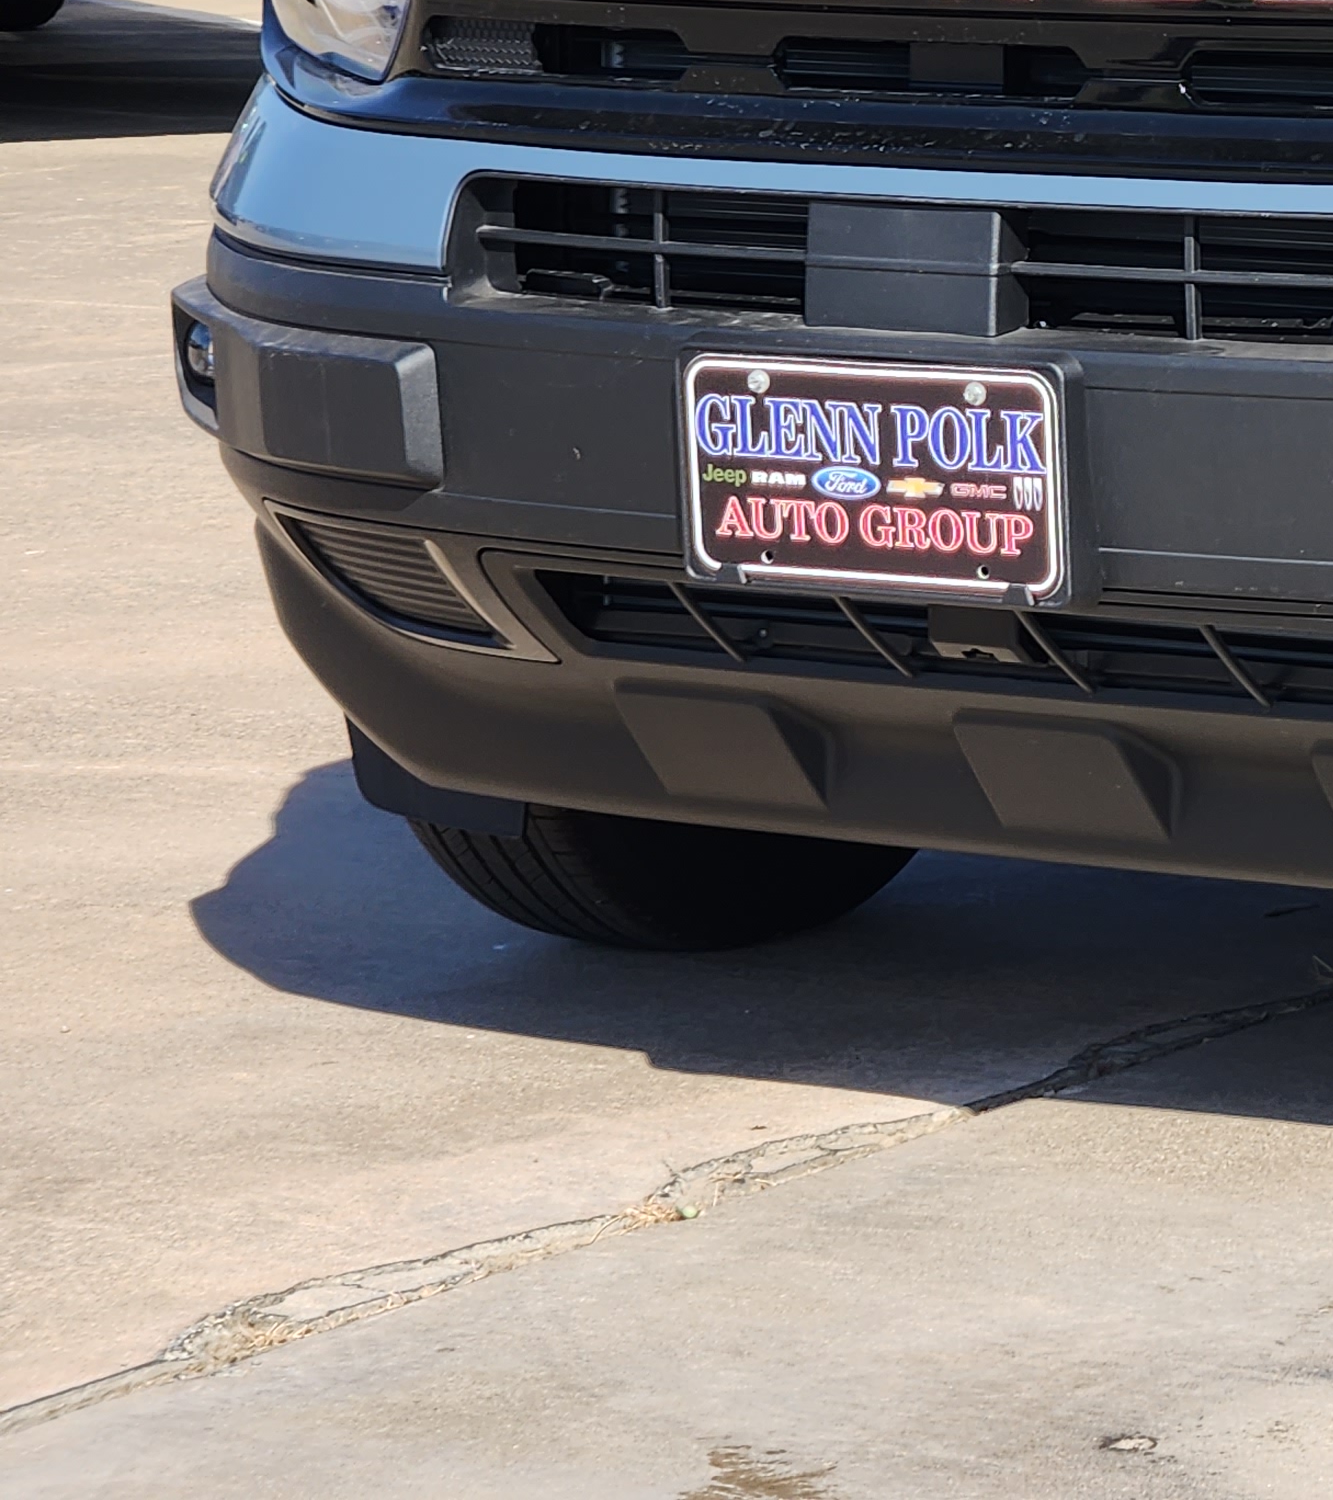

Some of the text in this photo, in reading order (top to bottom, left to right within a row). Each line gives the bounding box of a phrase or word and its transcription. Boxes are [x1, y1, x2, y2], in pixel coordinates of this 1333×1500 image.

[695, 393, 1046, 474] GLENN POLK
[702, 464, 1007, 499] Jeep RAM Ford GMC
[716, 496, 1034, 555] AUTO GROUP
